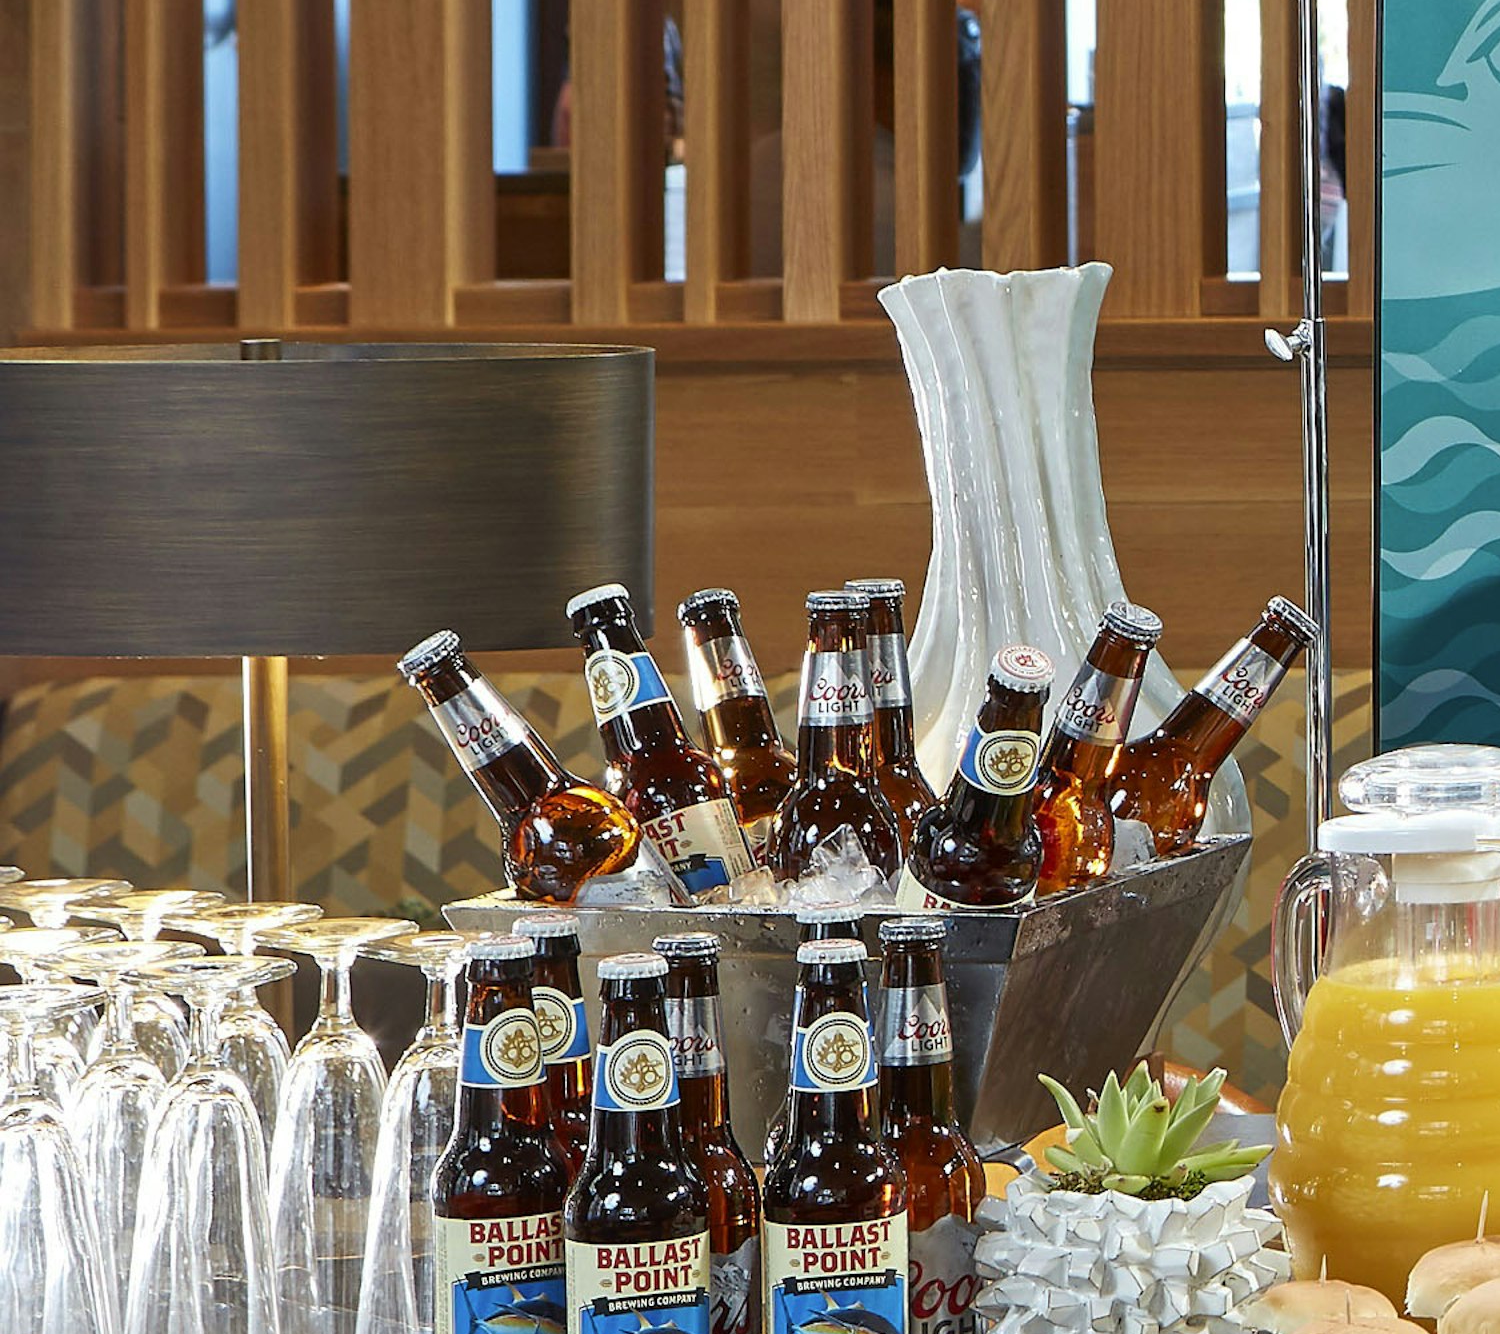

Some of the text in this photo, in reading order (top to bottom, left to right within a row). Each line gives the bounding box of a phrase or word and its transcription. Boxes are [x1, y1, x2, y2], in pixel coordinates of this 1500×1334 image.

[809, 677, 867, 701] Coors
[818, 700, 860, 714] LIGHT
[1067, 686, 1115, 724] Coors
[1065, 709, 1103, 734] LIGHT
[669, 1034, 714, 1054] oors
[469, 1214, 562, 1244] BALLAS
[787, 1220, 892, 1249] BALLAST
[488, 1238, 565, 1267] POINT
[597, 1238, 701, 1269] BALLAST
[803, 1246, 882, 1273] POINT
[481, 1270, 527, 1286] BREWING
[615, 1266, 693, 1293] POINT
[797, 1275, 887, 1291] BREWING COMPANY
[608, 1294, 697, 1312] BREWING COMPANY
